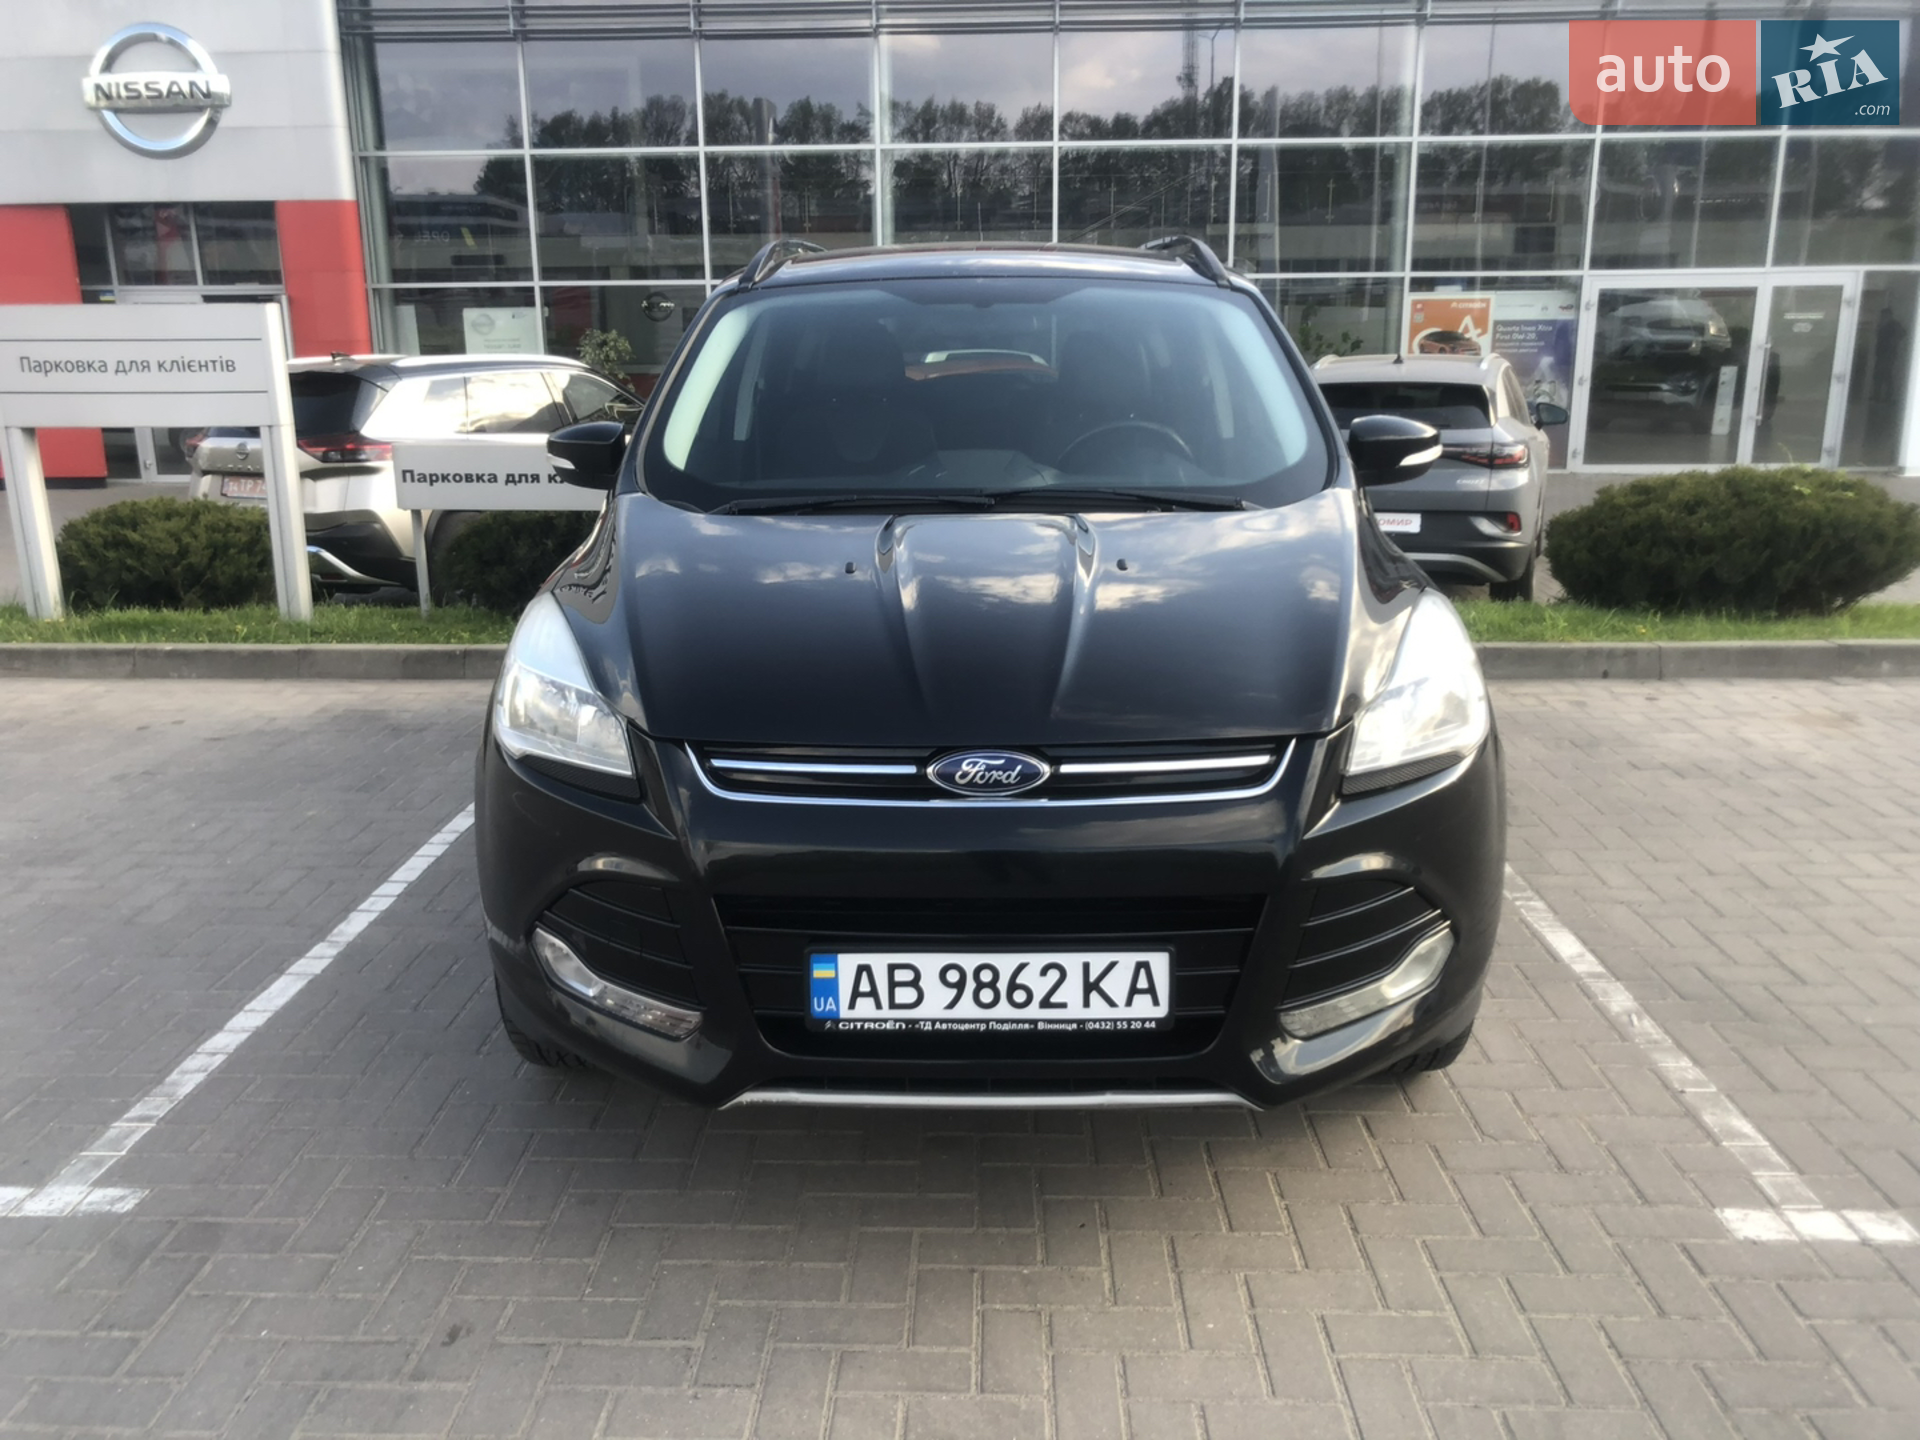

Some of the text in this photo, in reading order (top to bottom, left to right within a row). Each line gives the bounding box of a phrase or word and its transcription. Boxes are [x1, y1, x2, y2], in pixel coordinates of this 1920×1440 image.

[93, 80, 213, 101] NISSAN
[19, 356, 236, 377] Парковка для клієнтів
[402, 469, 498, 486] Парковка
[504, 473, 541, 486] для
[1379, 518, 1413, 526] ОМИР
[955, 758, 1023, 785] Ford
[847, 960, 1160, 1011] AB 9862 KA
[813, 997, 837, 1012] UA
[934, 1021, 987, 1032] Автоцентр
[1037, 1020, 1077, 1031] Вінниця
[1085, 1020, 1114, 1031] (0432)
[1116, 1020, 1128, 1030] 55
[1130, 1020, 1142, 1030] 20
[1143, 1020, 1156, 1030] 44
